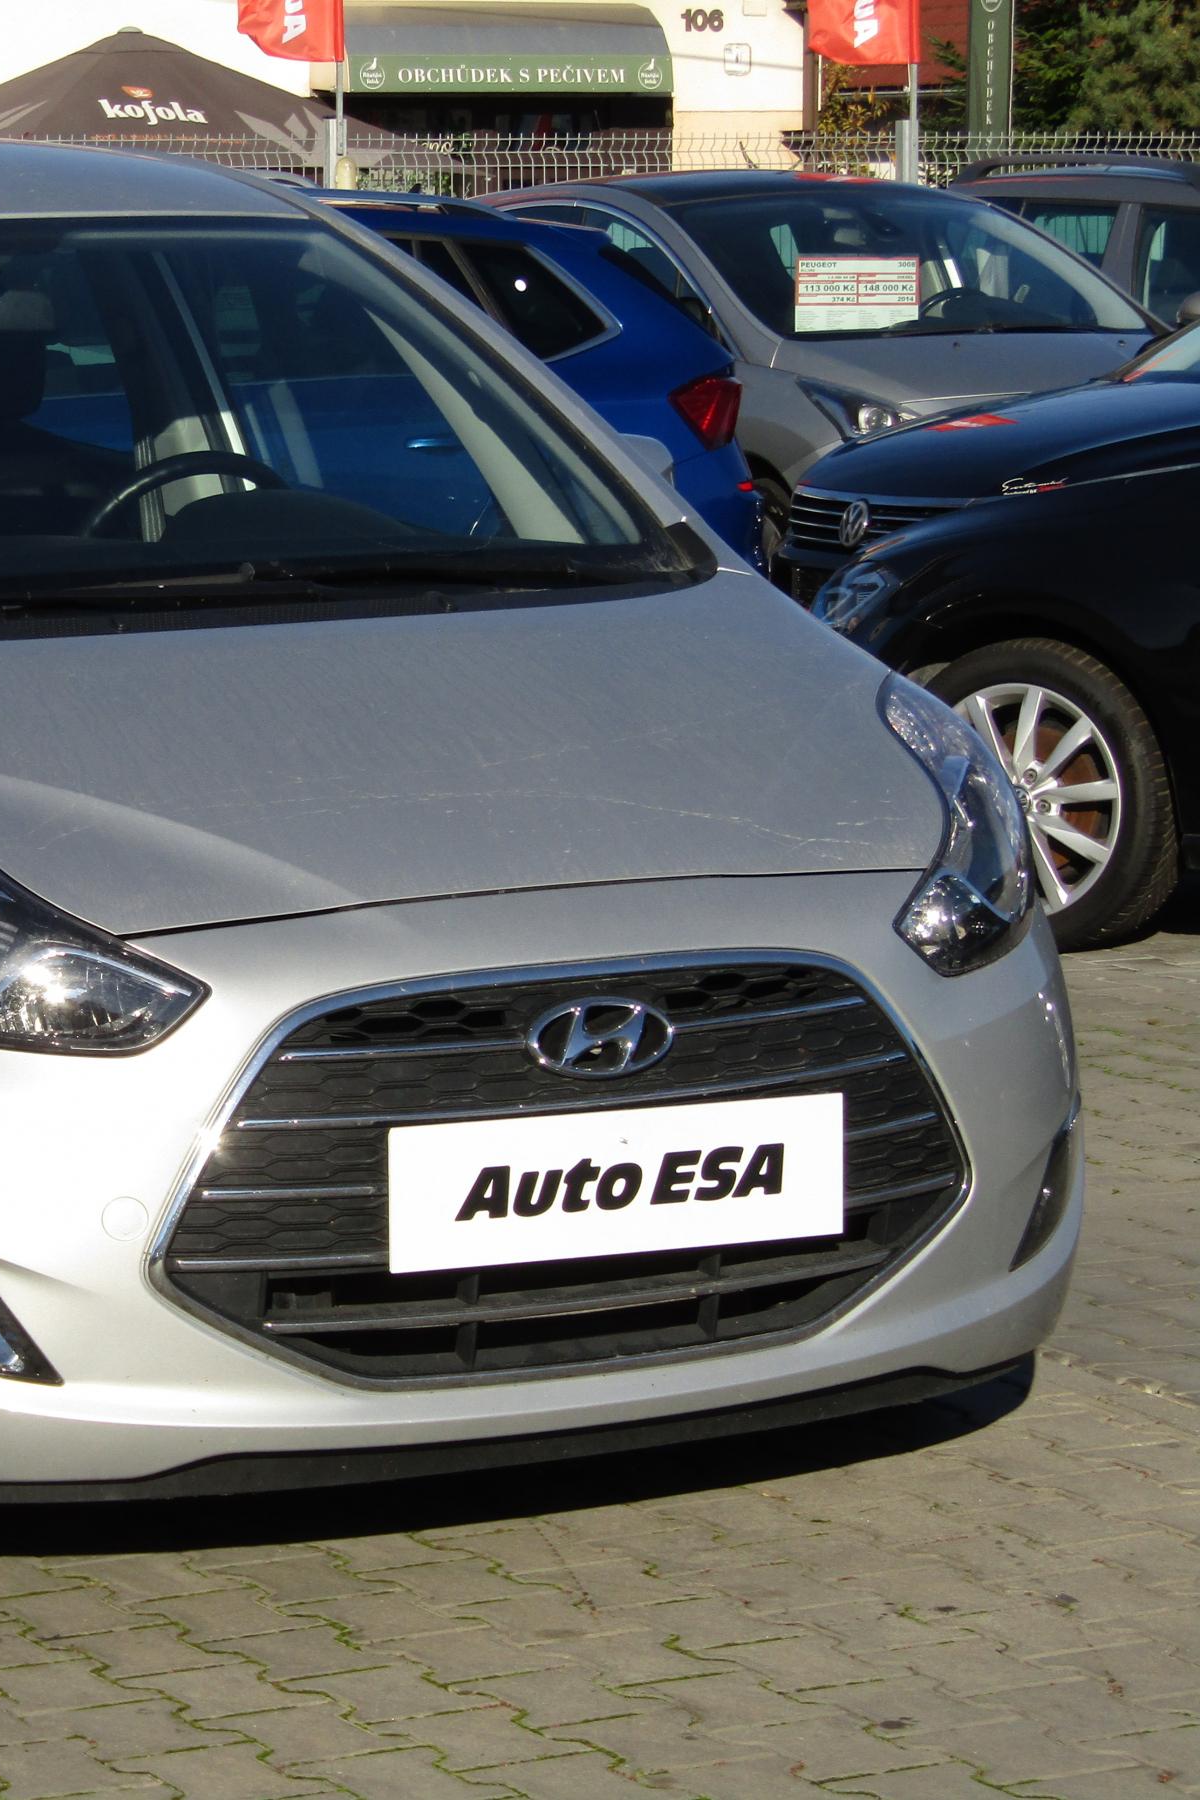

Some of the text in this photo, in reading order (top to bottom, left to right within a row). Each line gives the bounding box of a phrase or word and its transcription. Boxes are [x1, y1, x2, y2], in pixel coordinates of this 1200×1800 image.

[681, 8, 724, 32] 106
[398, 64, 512, 83] OBCHŮDEK
[519, 68, 530, 83] S
[537, 65, 625, 83] PEČIVEM
[805, 284, 821, 292] 113
[823, 284, 840, 292] 000
[863, 284, 880, 292] 148
[882, 284, 899, 292] 000
[455, 1143, 784, 1221] Auto ESA
